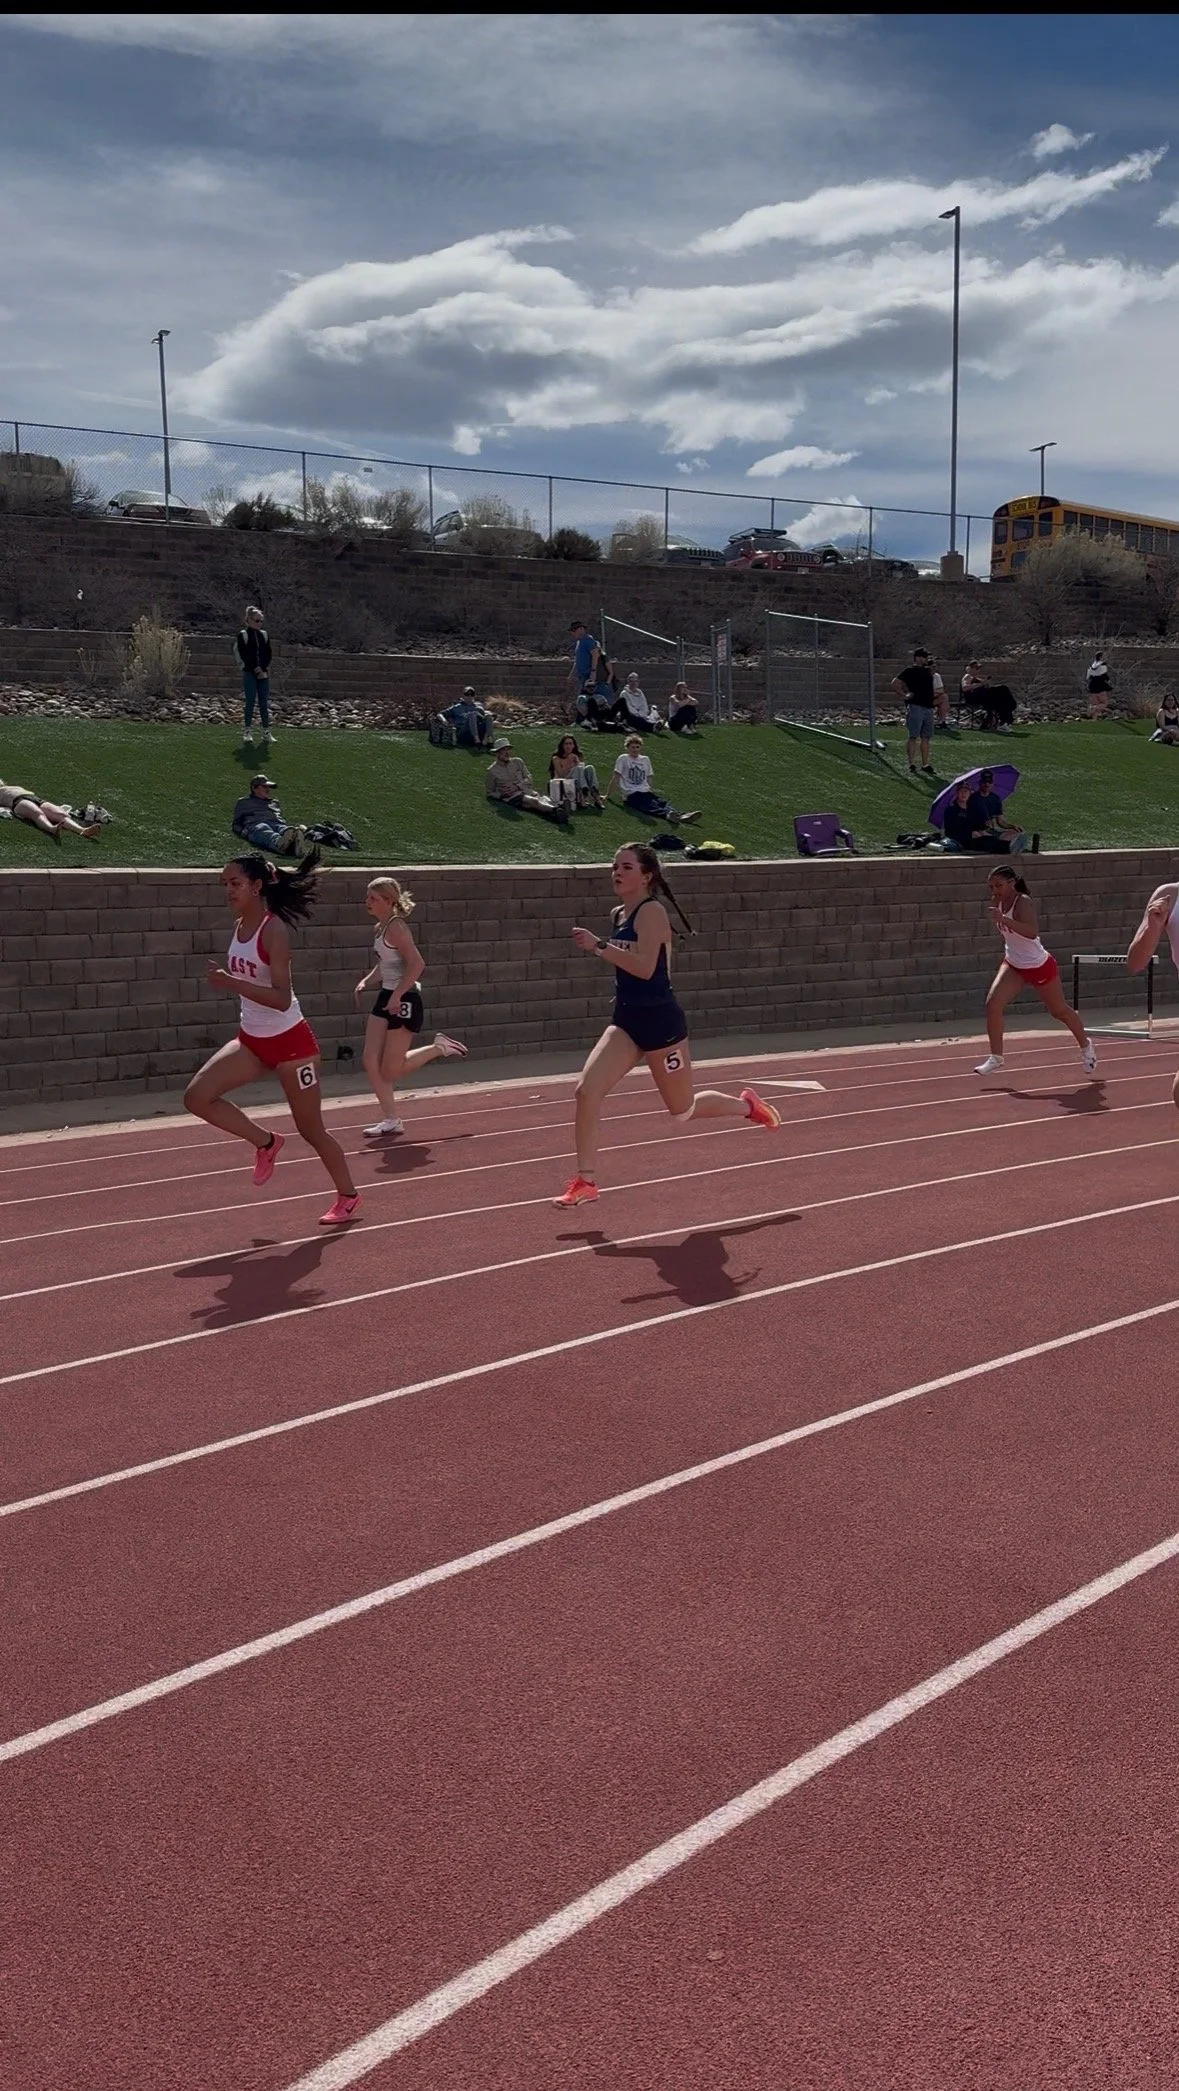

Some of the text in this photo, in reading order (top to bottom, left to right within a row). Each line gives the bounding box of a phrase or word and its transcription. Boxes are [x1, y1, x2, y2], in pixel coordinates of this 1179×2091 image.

[231, 956, 257, 978] AST
[400, 1003, 409, 1017] 8
[667, 1051, 681, 1070] 5
[300, 1066, 313, 1086] 6
